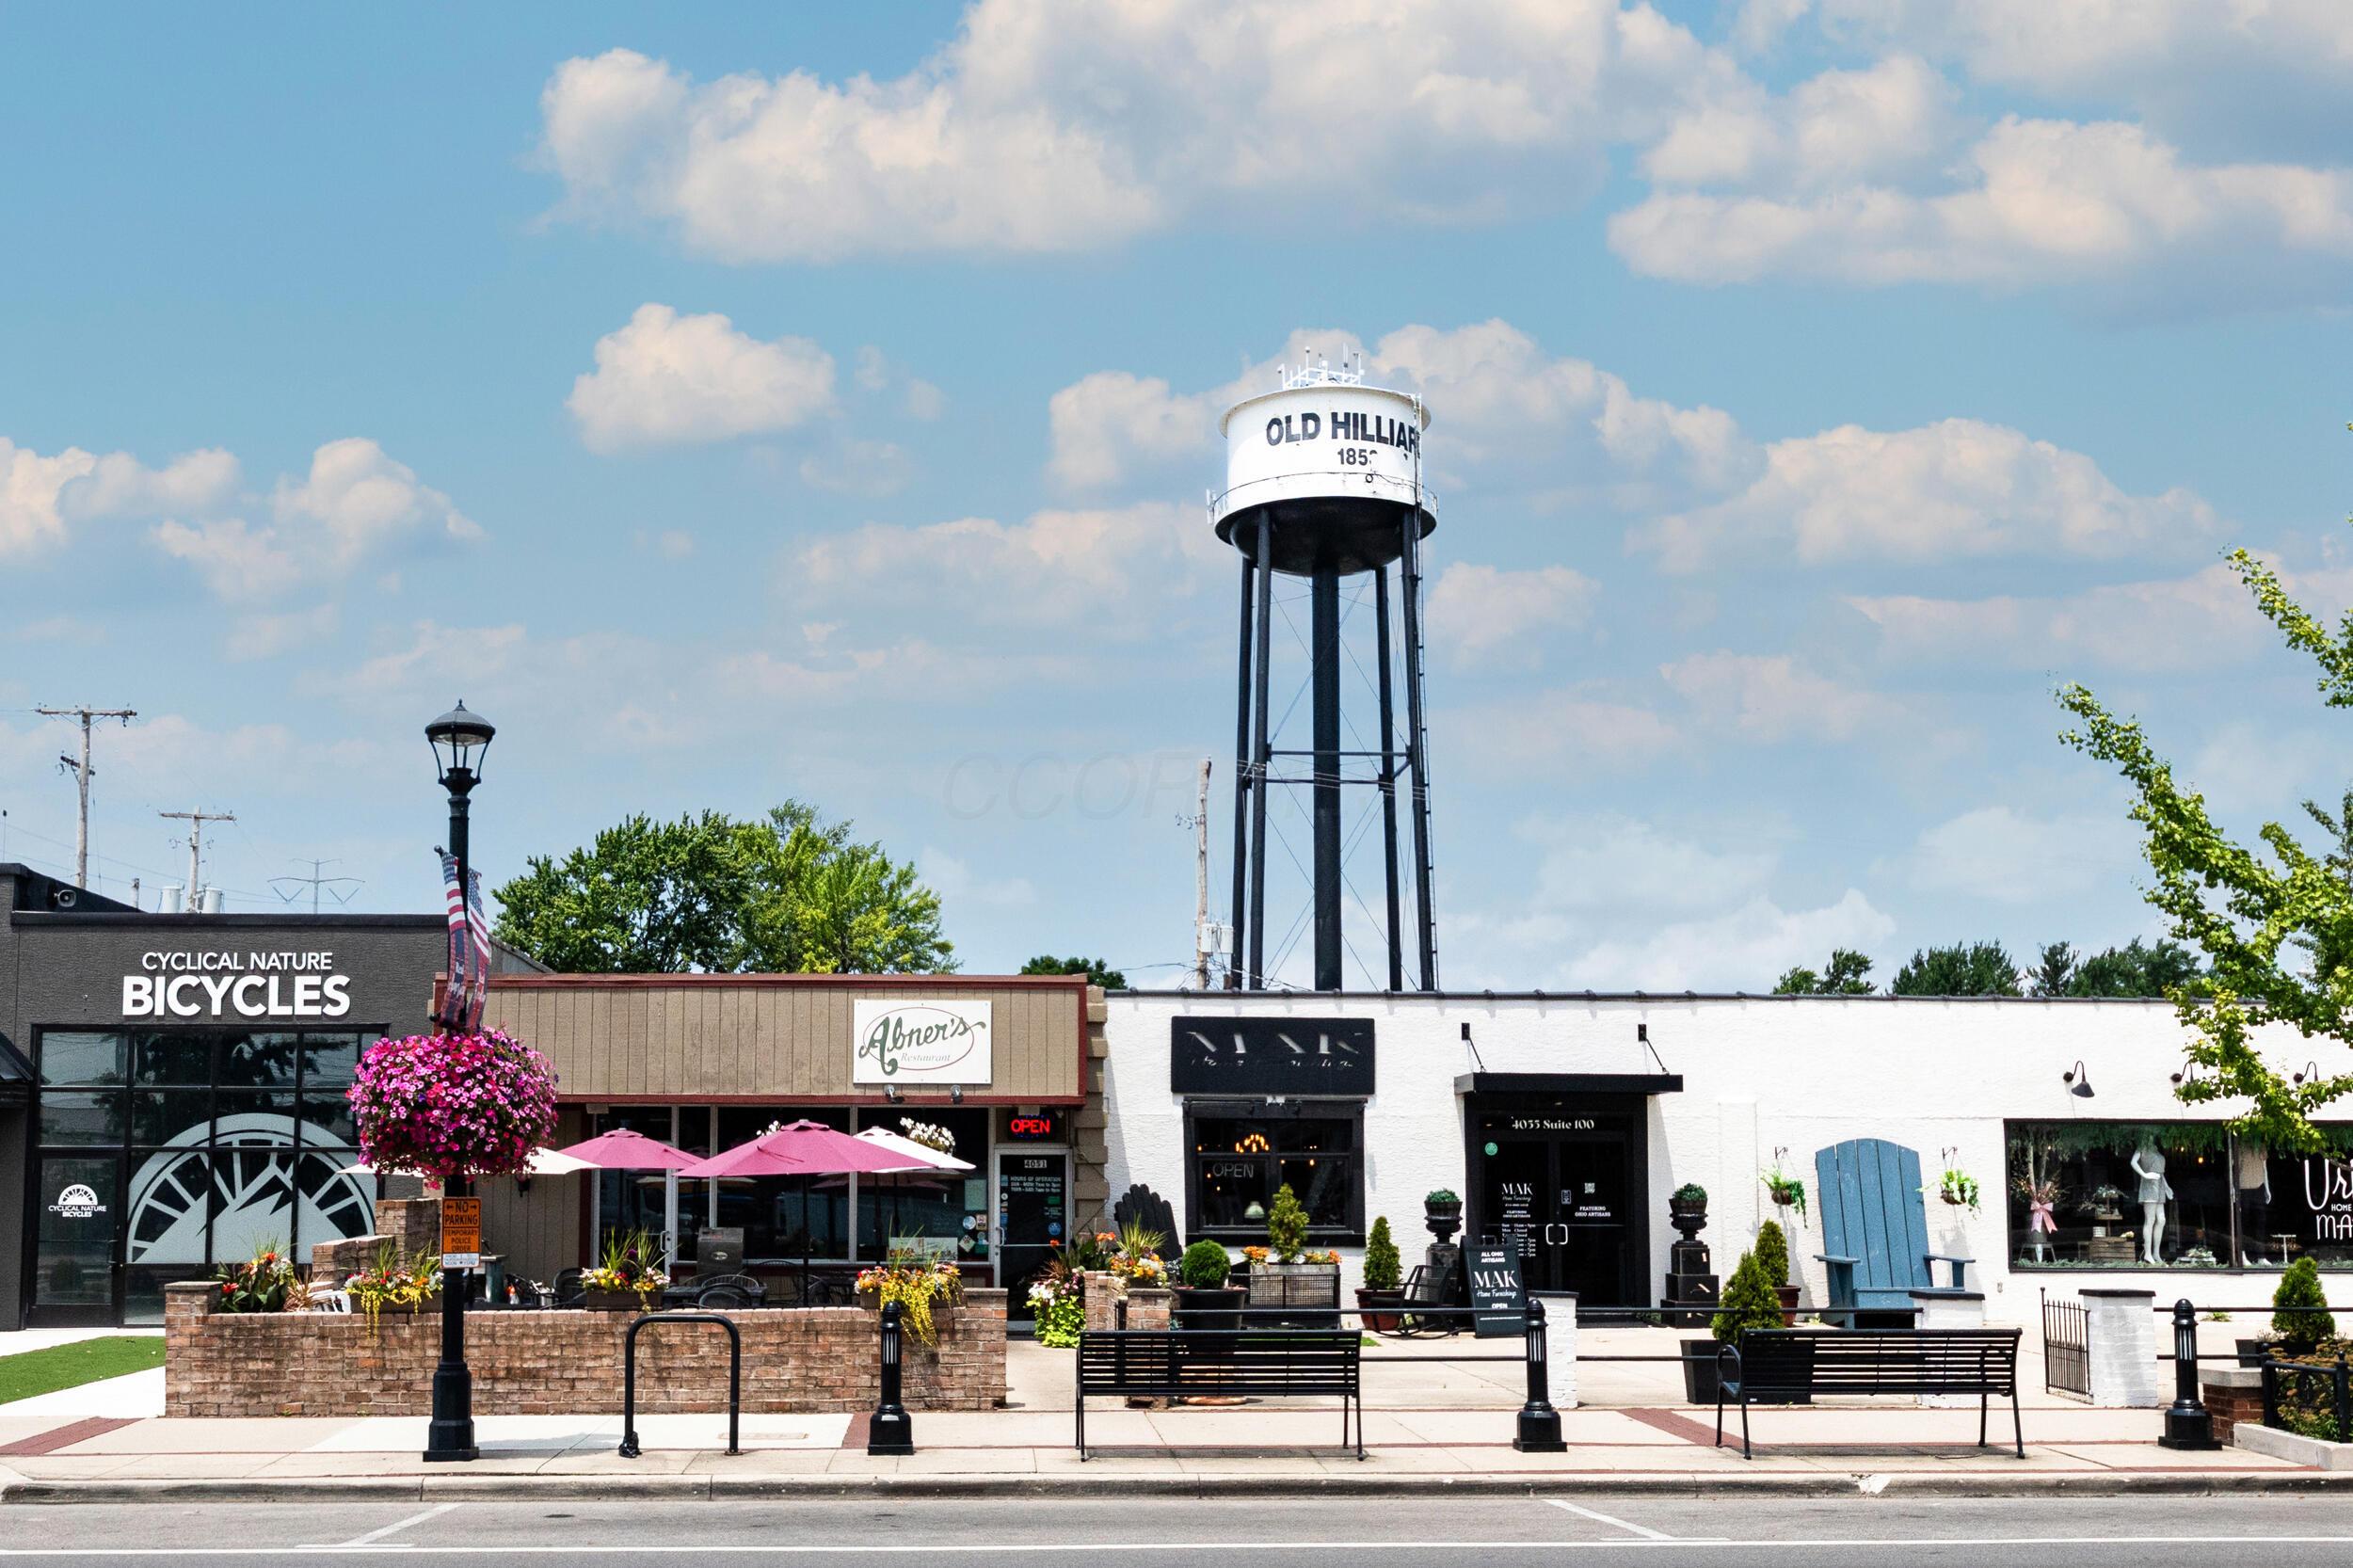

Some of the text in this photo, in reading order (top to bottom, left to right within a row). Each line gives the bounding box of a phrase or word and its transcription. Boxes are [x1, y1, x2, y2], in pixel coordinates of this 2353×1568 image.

[1266, 412, 1321, 446] OLD
[142, 952, 332, 970] CYCLICAL NATURE
[122, 974, 351, 1016] BICYCLES
[858, 1016, 986, 1076] Abner's
[901, 1052, 951, 1062] Restaurant
[1010, 1118, 1051, 1135] OPEN
[1543, 1119, 1573, 1129] Suite
[1574, 1119, 1595, 1129] 100
[1024, 1160, 1047, 1168] 4051
[1212, 1162, 1255, 1178] OPEN
[1501, 1183, 1533, 1195] MAK
[2304, 1158, 2353, 1210] Ur
[456, 1202, 468, 1212] NO
[445, 1214, 477, 1225] PARKING
[1473, 1271, 1518, 1288] MAK
